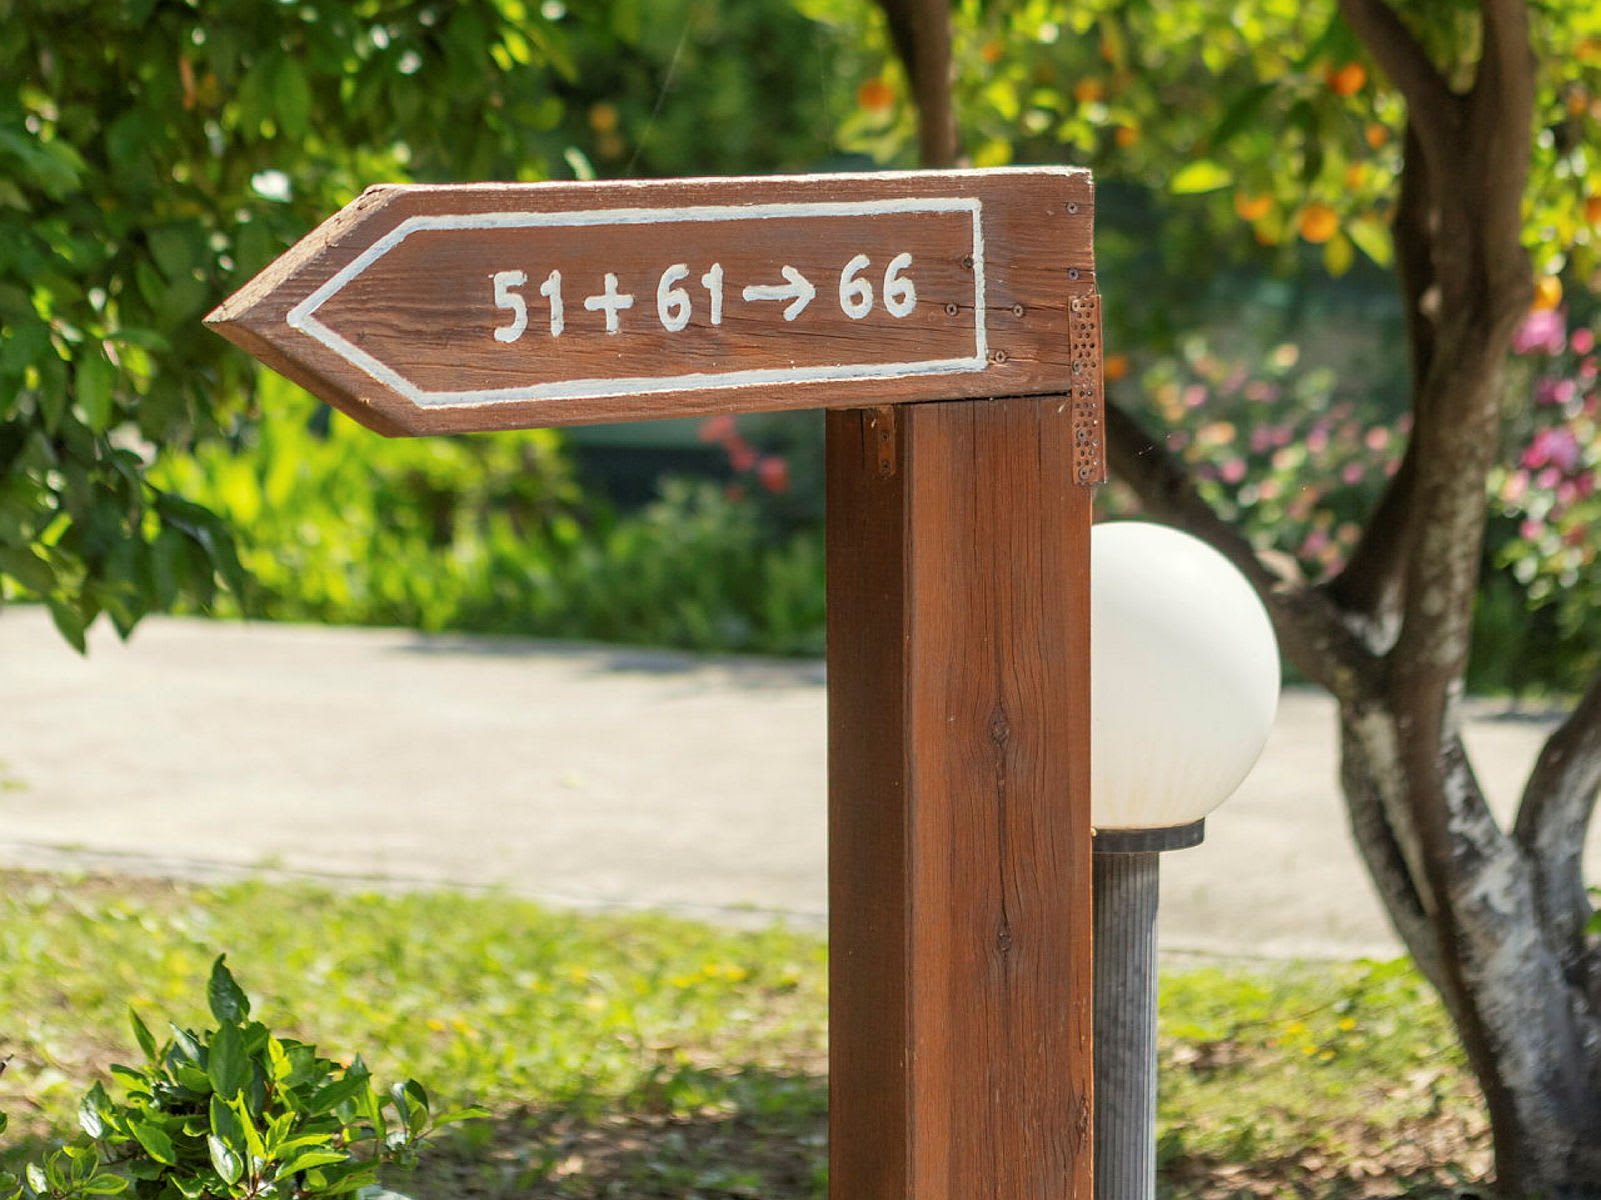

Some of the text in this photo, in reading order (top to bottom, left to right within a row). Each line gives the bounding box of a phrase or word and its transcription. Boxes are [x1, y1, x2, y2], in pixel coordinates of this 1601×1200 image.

[491, 269, 567, 345] 51
[655, 262, 725, 333] 61
[837, 252, 919, 320] 66
